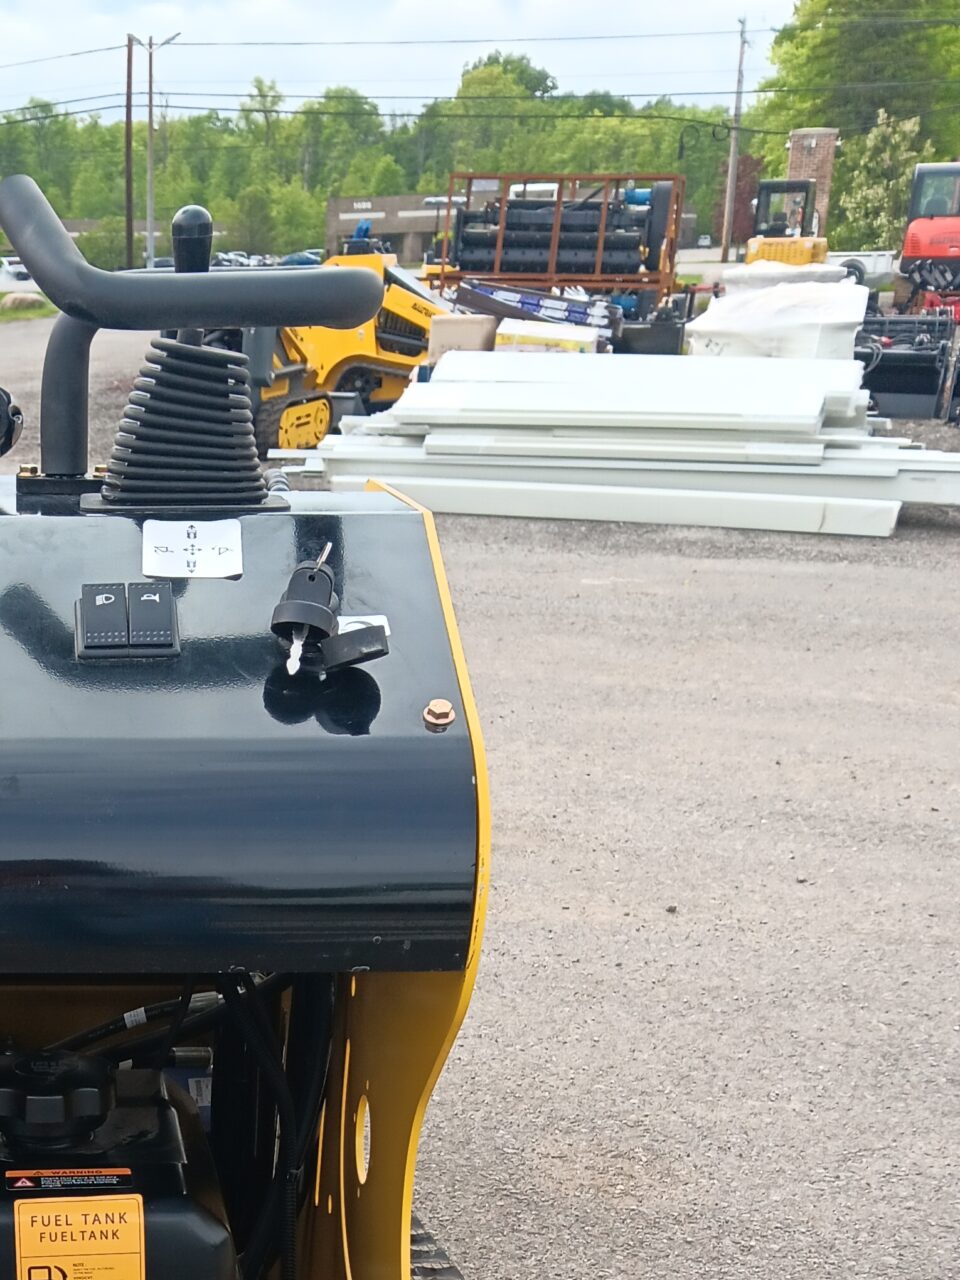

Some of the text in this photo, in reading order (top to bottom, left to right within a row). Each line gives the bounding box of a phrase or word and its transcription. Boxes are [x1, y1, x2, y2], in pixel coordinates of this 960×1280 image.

[30, 1212, 128, 1228] FUEL TANK
[39, 1229, 120, 1243] FUELTANK
